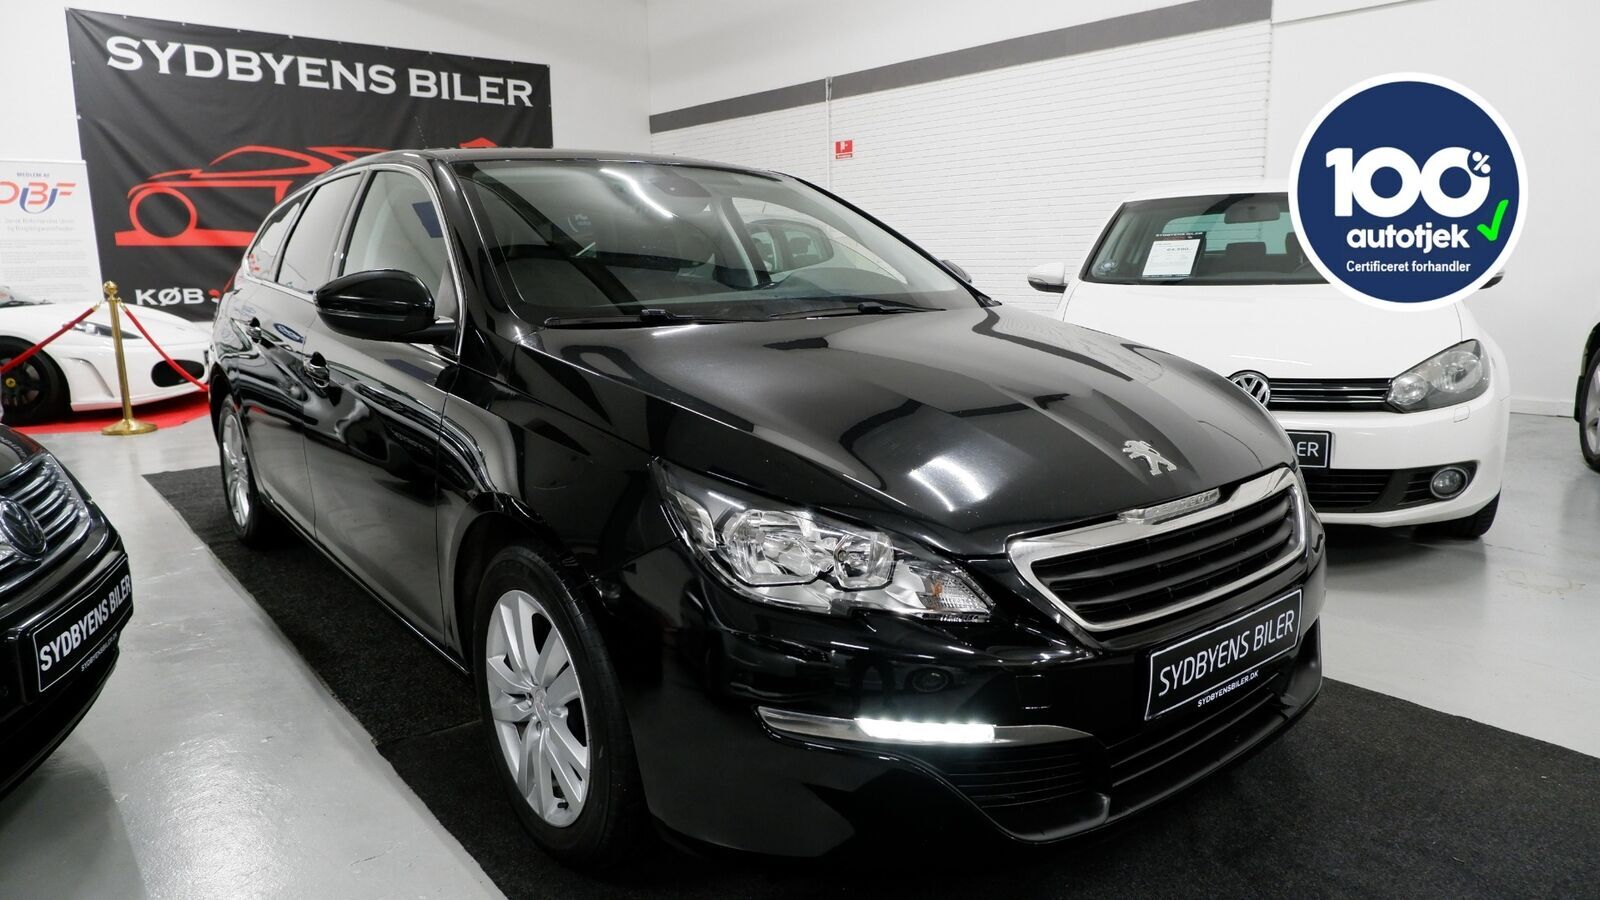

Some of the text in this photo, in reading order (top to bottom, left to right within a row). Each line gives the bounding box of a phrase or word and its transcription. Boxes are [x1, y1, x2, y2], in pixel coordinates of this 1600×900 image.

[106, 36, 533, 107] SYDBYENS BILER
[135, 287, 205, 307] KØB
[1296, 441, 1319, 457] ER
[39, 574, 132, 672] SYDBYENS BILER
[1158, 609, 1295, 697] SYDBYENS BILER
[1197, 669, 1260, 708] SYDBYENSBILER.DK
